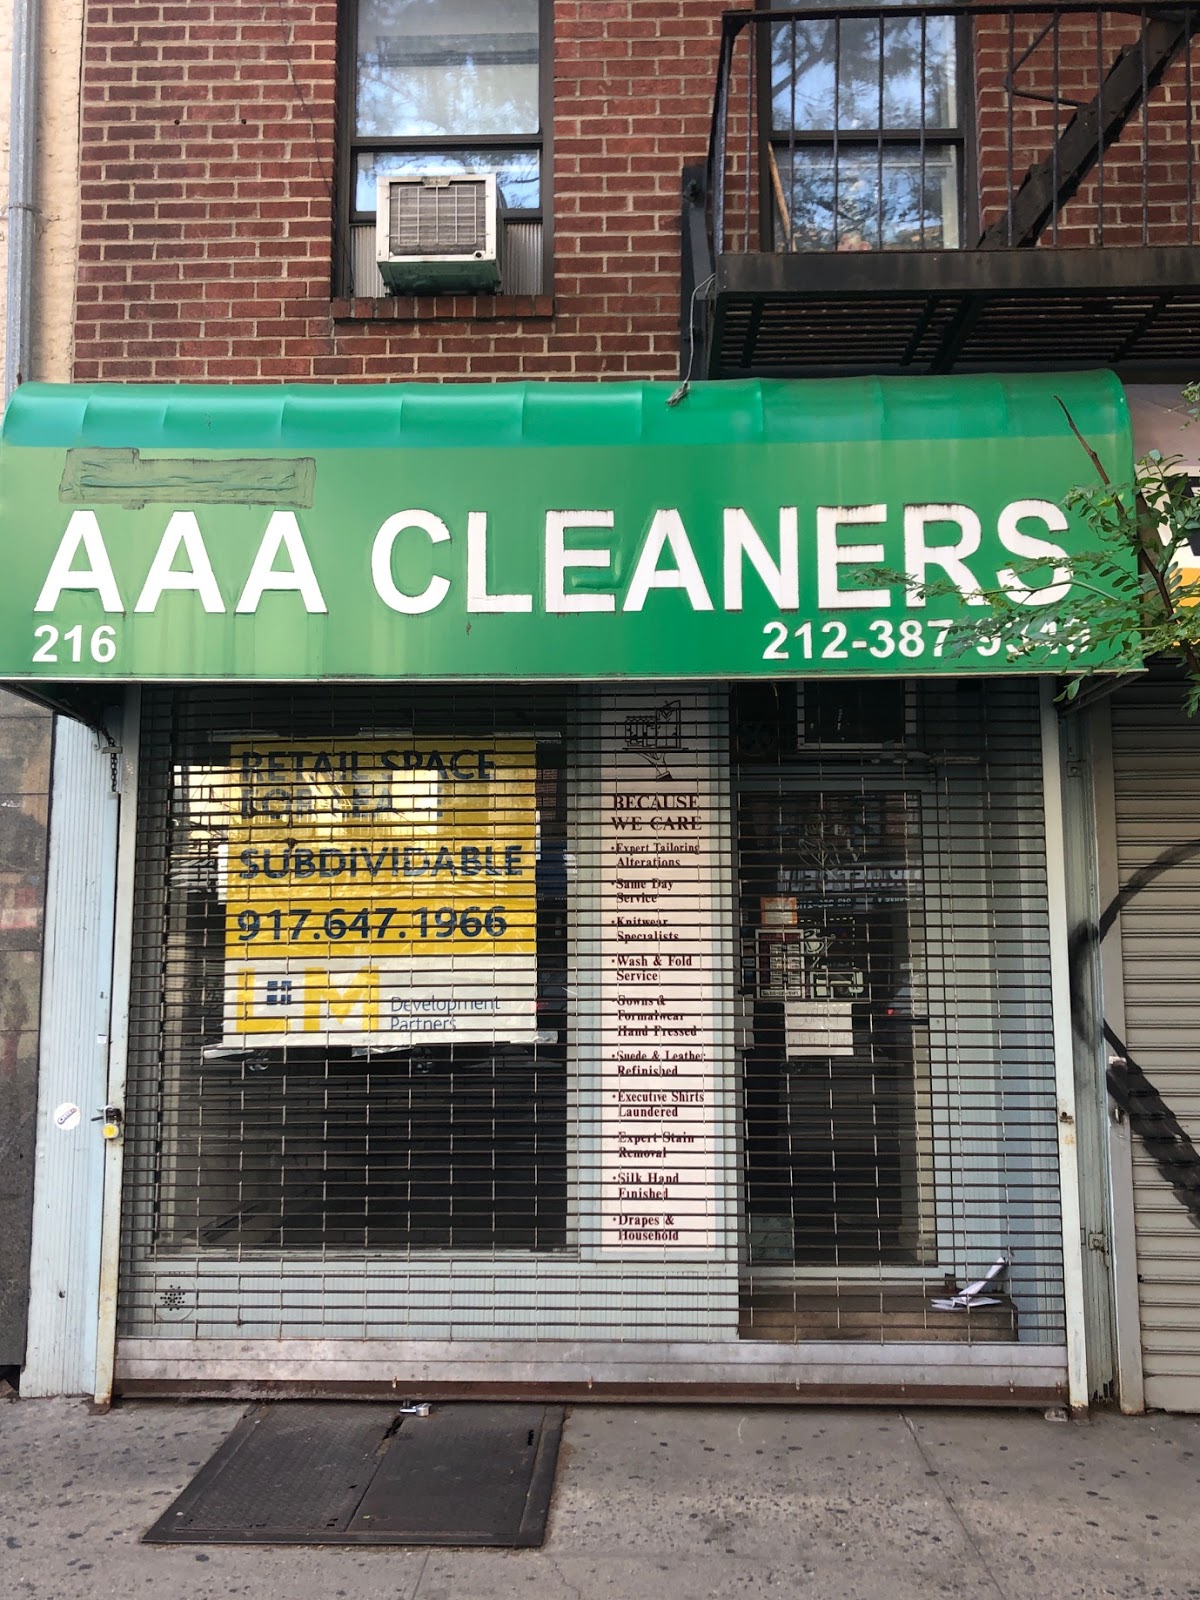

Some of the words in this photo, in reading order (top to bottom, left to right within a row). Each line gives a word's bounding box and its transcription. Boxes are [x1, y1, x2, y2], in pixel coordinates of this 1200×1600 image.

[33, 509, 329, 615] AAA
[370, 499, 1073, 615] CLEANERS
[31, 624, 117, 664] 216
[242, 751, 367, 782] RETAIL
[381, 749, 495, 780] SPACE
[613, 793, 700, 810] BECAUSE
[611, 816, 642, 831] WE
[650, 816, 702, 831] CARE
[616, 842, 649, 856] Expert
[653, 842, 700, 856] Tailoring
[238, 845, 523, 879] SUBDIVIDABLE
[617, 857, 681, 869] Alterations
[616, 878, 646, 889] Same
[652, 878, 673, 891] Day
[616, 892, 657, 904] Service
[237, 906, 507, 941] 917.647.1966
[617, 930, 680, 944] Specialists
[617, 953, 648, 967] Wash
[653, 954, 662, 967] &
[668, 953, 692, 967] Fold
[616, 969, 658, 982] Service
[391, 995, 500, 1014] Development
[657, 994, 666, 1006] &
[391, 1016, 457, 1032] Partners
[617, 1024, 648, 1037] Hand
[616, 1049, 647, 1061] Suede
[652, 1049, 660, 1061] &
[617, 1065, 678, 1076] Refinished
[618, 1090, 667, 1103] Executive
[671, 1090, 705, 1103] Shirts
[618, 1106, 678, 1118] Laundered
[618, 1146, 667, 1158] Removal
[617, 1172, 642, 1184] Silk
[648, 1172, 679, 1184] Hand
[618, 1187, 669, 1199] Finished
[618, 1215, 660, 1227] Drapes
[665, 1215, 675, 1226] &
[618, 1230, 679, 1241] Household
